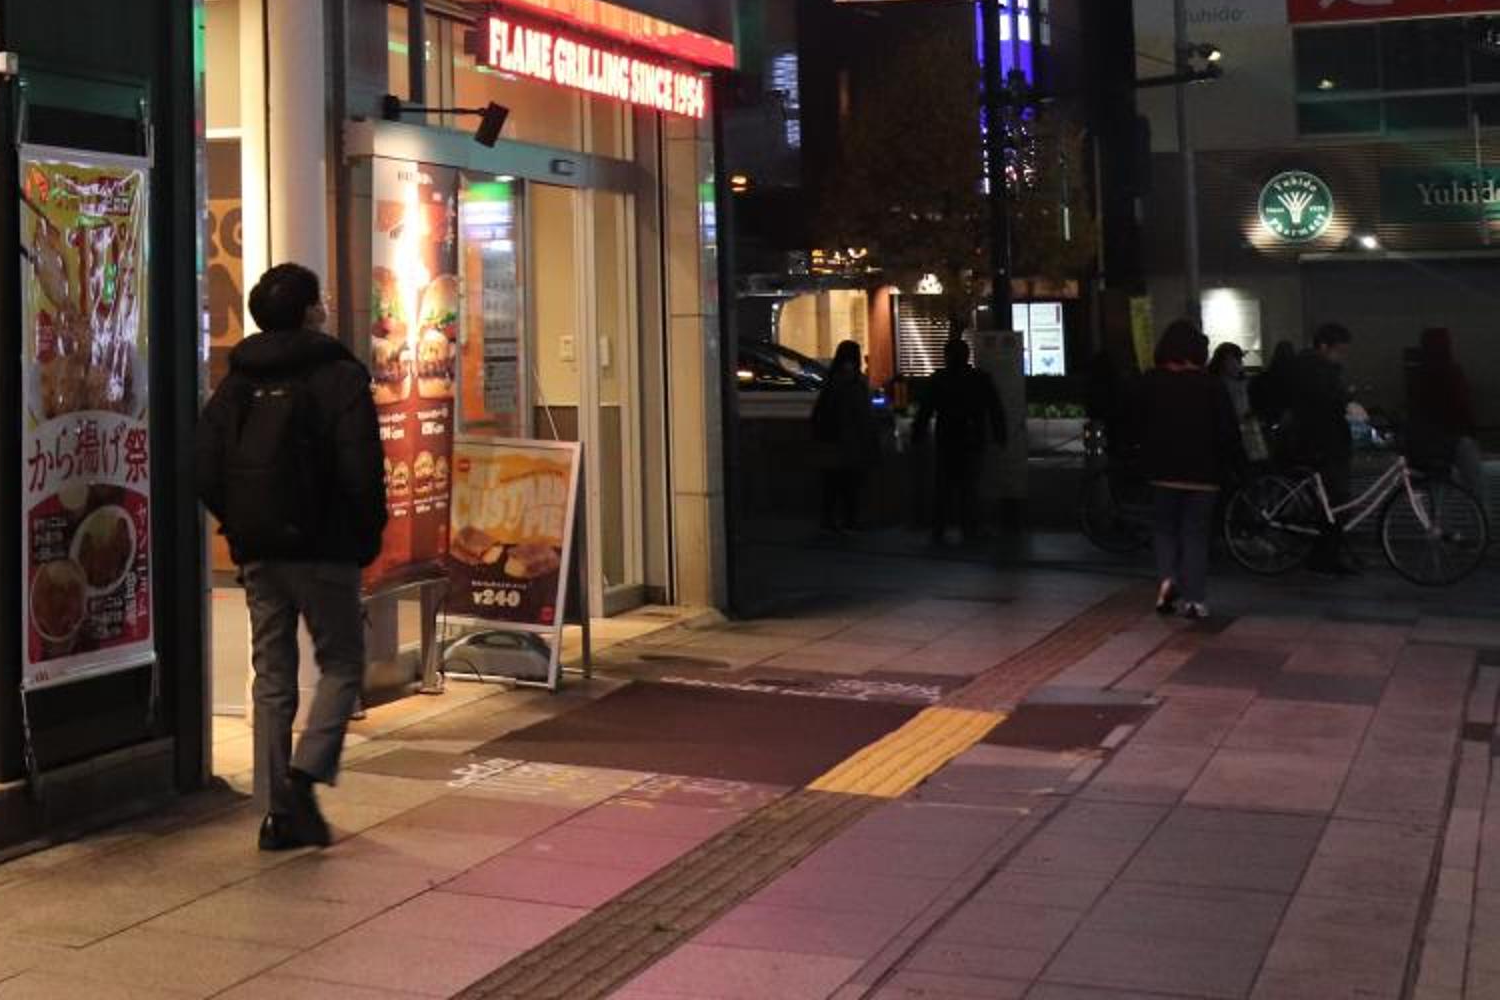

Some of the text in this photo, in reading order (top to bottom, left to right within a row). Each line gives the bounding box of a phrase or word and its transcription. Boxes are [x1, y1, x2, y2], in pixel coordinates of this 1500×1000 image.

[489, 17, 552, 80] FLAME
[553, 37, 630, 101] GRILLING
[630, 59, 673, 111] SINCE
[674, 72, 705, 119] 1954
[27, 419, 148, 492] から揚げ祭
